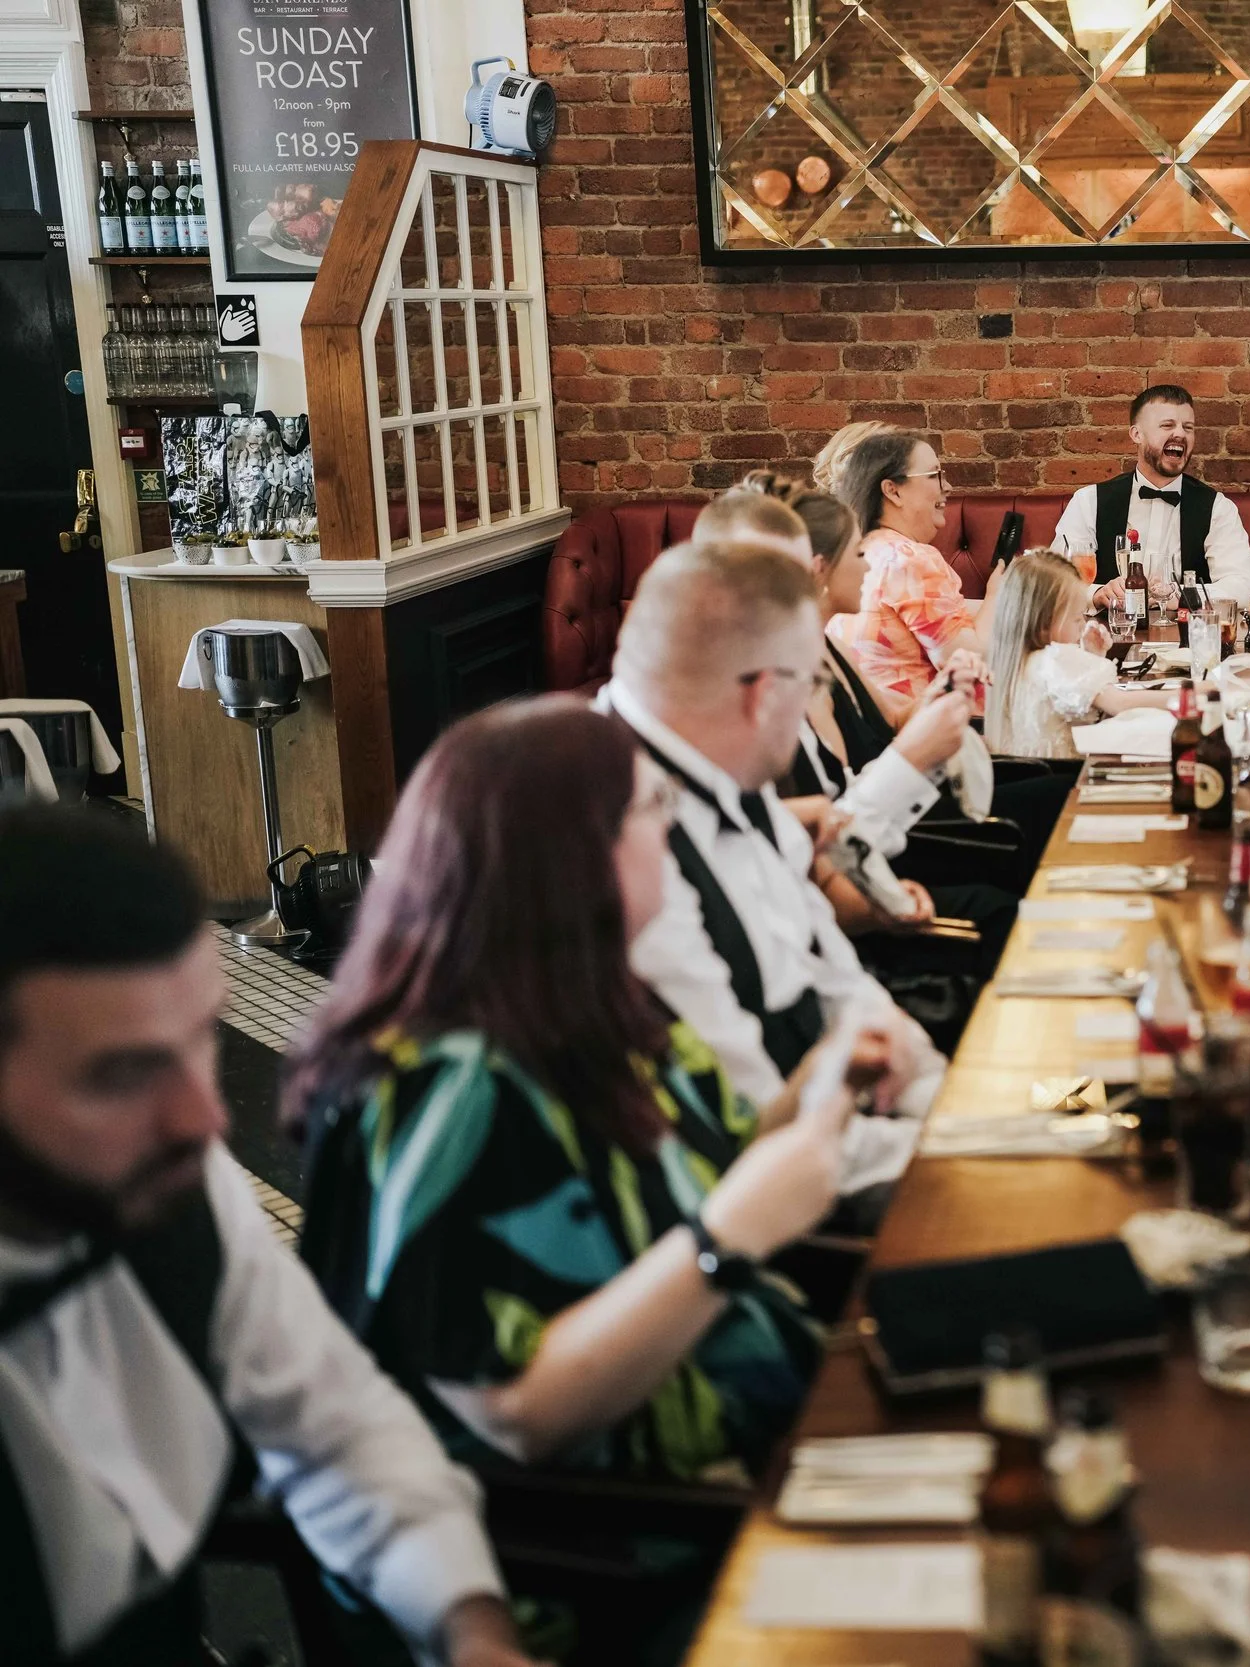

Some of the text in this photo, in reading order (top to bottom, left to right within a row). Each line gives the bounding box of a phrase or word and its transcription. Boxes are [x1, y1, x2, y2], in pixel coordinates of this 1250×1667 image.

[237, 27, 374, 55] SUNDAY
[255, 60, 363, 88] ROAST
[273, 98, 314, 110] 12noon
[324, 97, 351, 114] 9pm
[303, 117, 325, 128] from
[275, 131, 359, 157] £18.95
[233, 163, 254, 172] FULL
[254, 163, 262, 172] A
[263, 163, 274, 172] LA
[275, 163, 303, 172] CARTE
[305, 163, 332, 172] MENU
